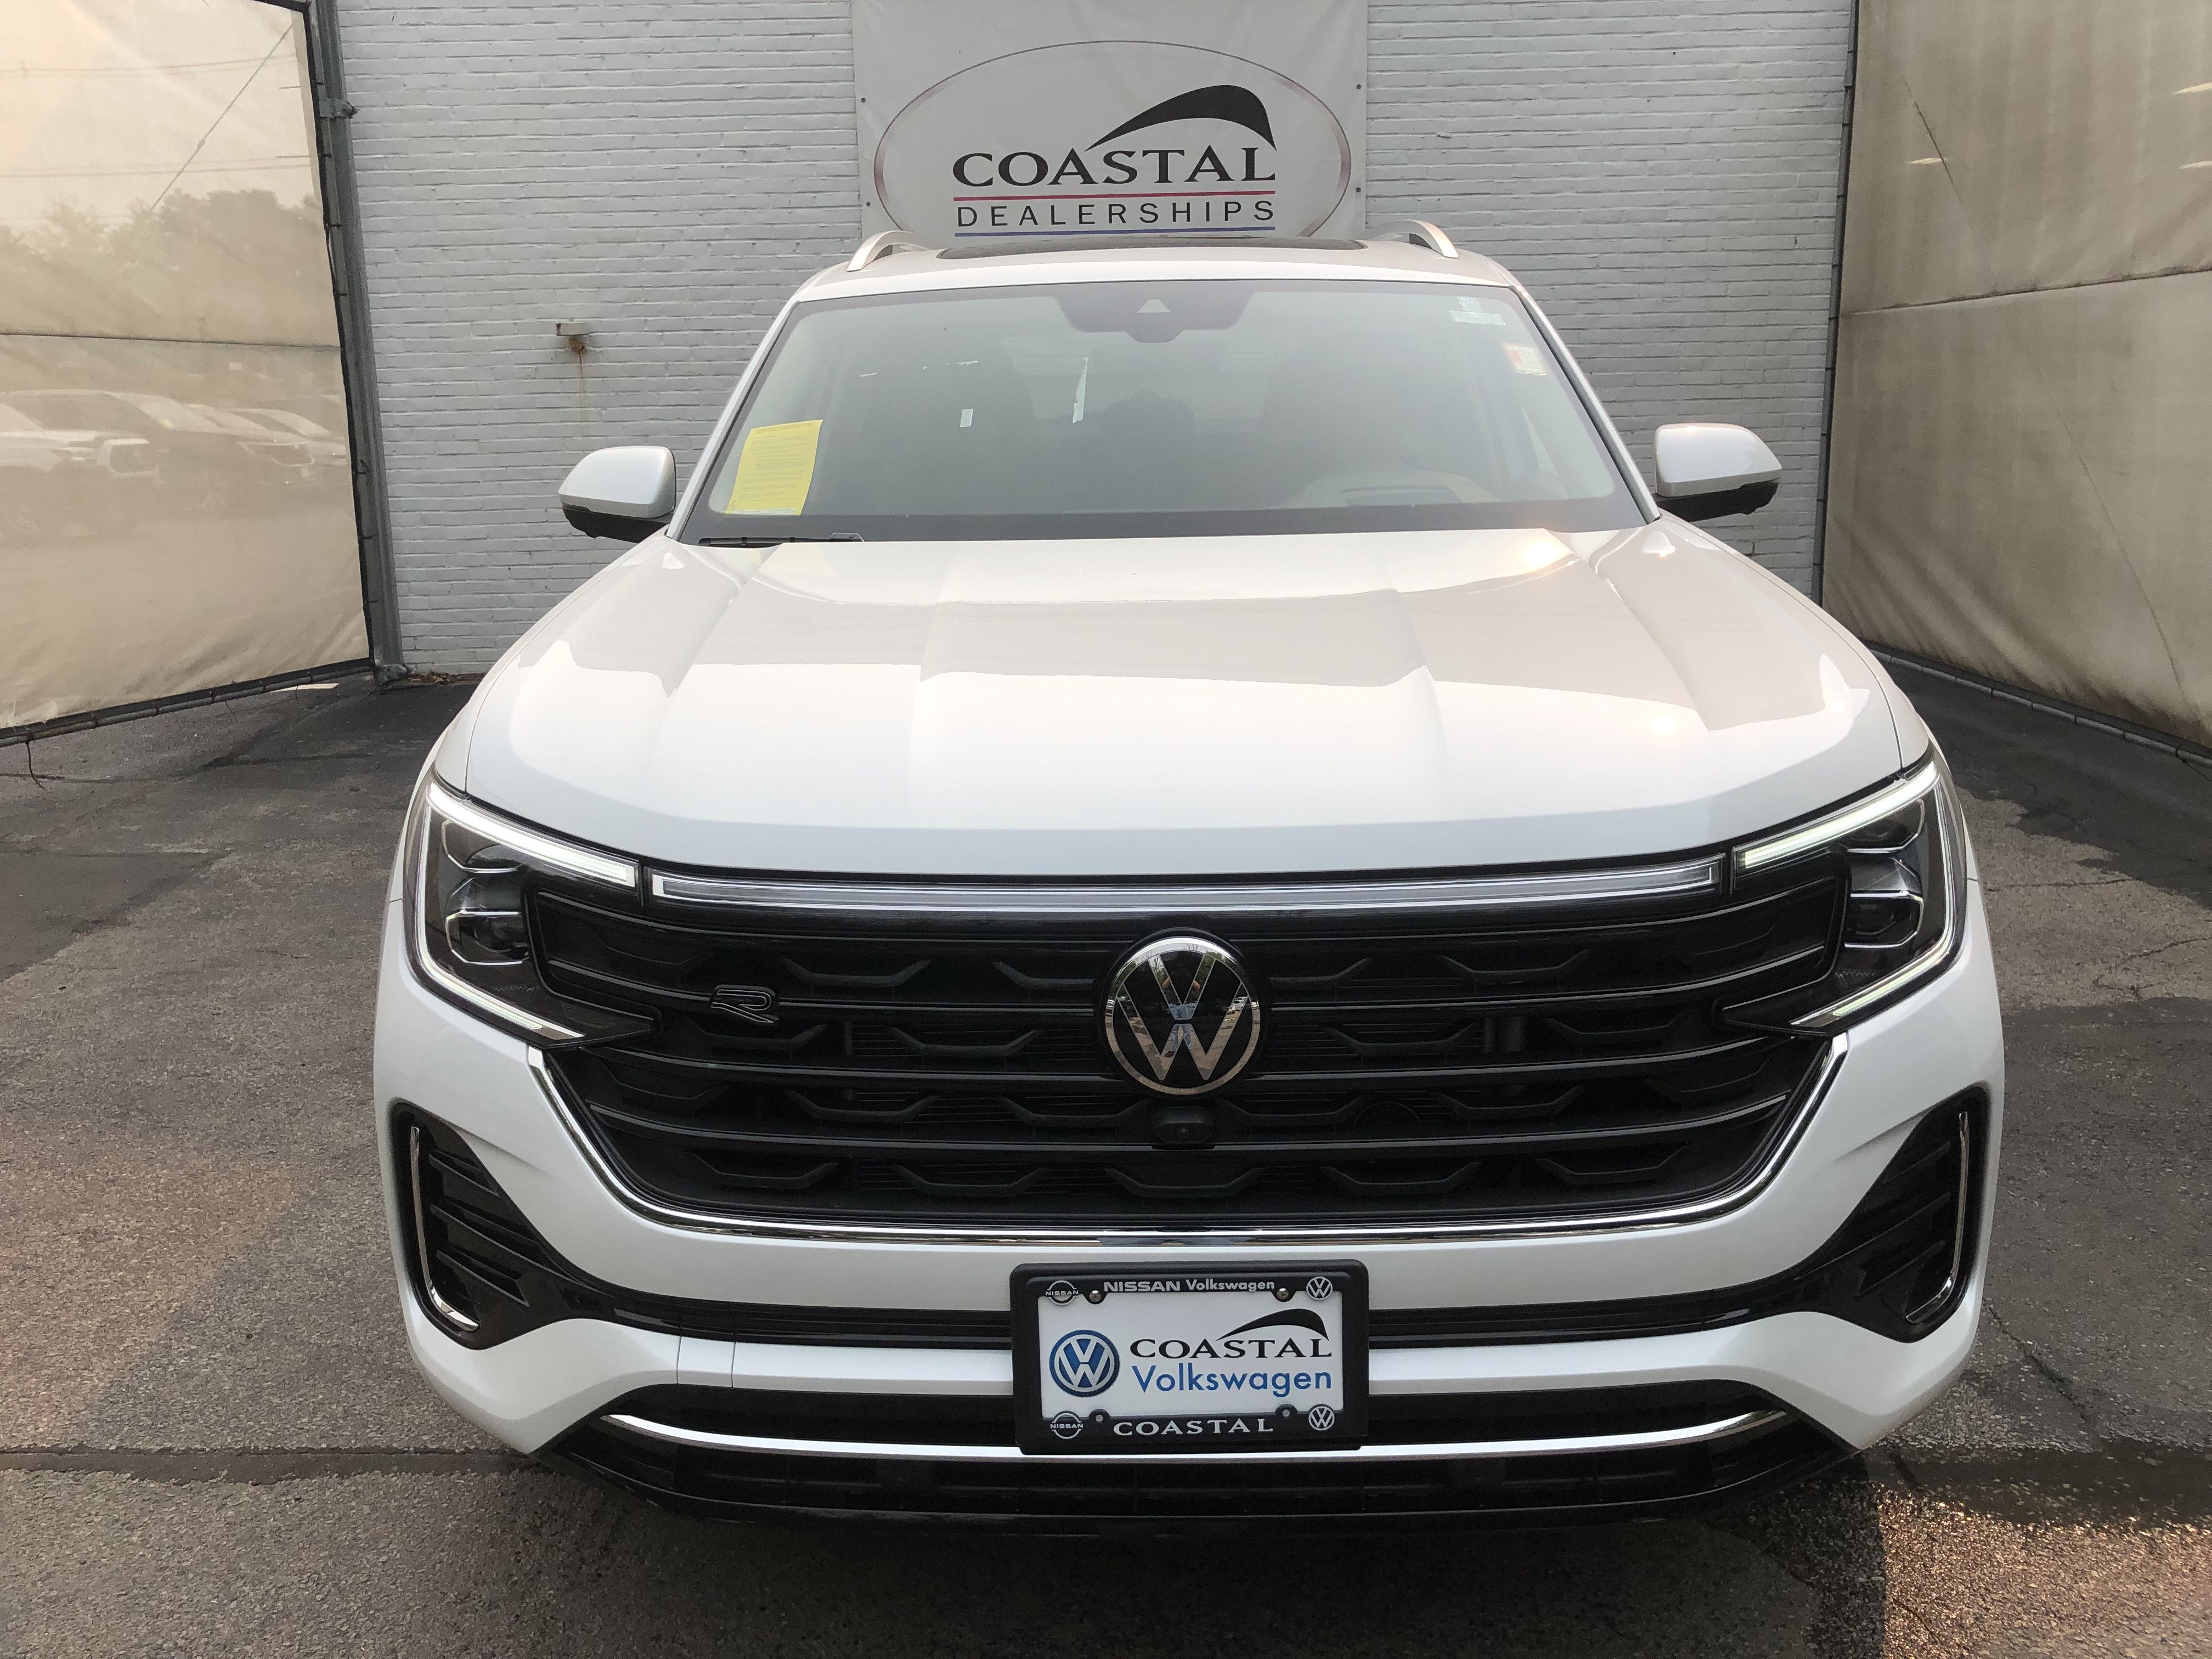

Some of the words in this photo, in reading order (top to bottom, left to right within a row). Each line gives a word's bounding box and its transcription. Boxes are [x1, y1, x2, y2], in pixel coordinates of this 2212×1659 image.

[952, 145, 1276, 187] COASTAL
[958, 201, 1274, 227] DEALERSHIPS
[1104, 1281, 1181, 1291] NISSAN
[1186, 1279, 1274, 1291] Volkswagen
[1130, 1338, 1332, 1358] COASTAL
[1132, 1362, 1331, 1397] Volkswagen
[1113, 1418, 1273, 1436] COASTAL
